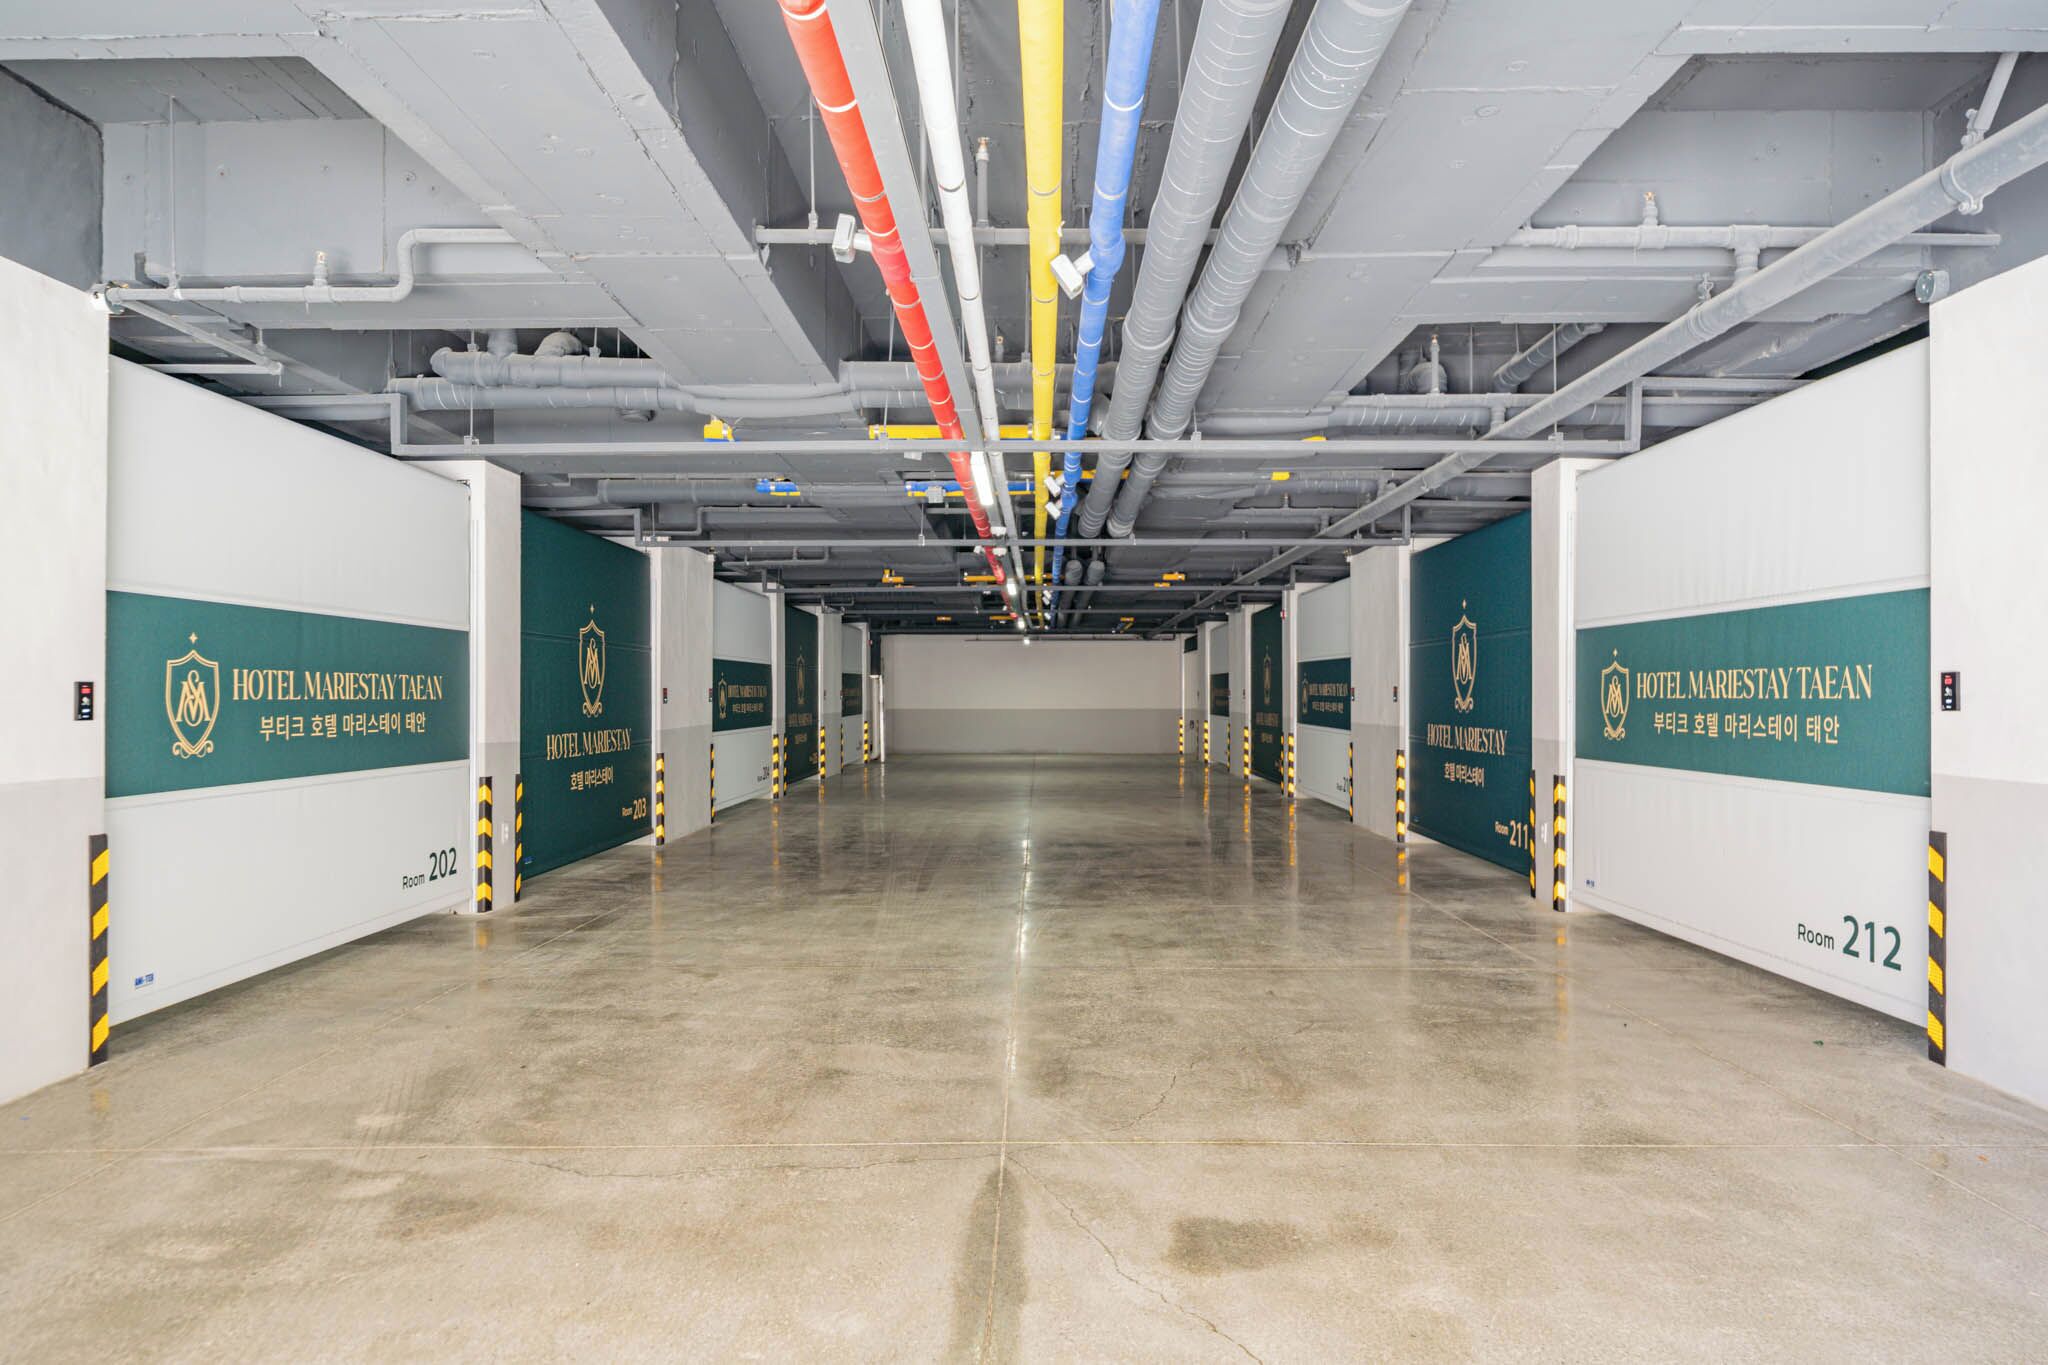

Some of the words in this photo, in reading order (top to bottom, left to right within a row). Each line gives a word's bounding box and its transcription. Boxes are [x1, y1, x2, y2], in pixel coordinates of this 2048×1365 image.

[233, 669, 301, 700] HOTEL
[304, 671, 398, 700] MARIESTAY
[399, 673, 443, 700] TAEAN
[1637, 671, 1686, 699] HOTEL
[1688, 667, 1793, 699] MARIESTAY
[1796, 664, 1872, 699] TAEAN
[260, 715, 304, 741] 부티크
[311, 714, 337, 738] 호텔
[343, 712, 400, 736] 마리스테이
[405, 712, 426, 733] 태안
[1427, 723, 1453, 749] HOTEL
[1654, 712, 1688, 735] 부티크
[1693, 712, 1718, 737] 호텔
[1725, 712, 1798, 742] 마리스테이
[1806, 714, 1840, 744] 태안
[546, 732, 581, 760] HOTEL
[582, 728, 631, 756] MARIESTAY
[633, 797, 647, 820] 203
[1510, 820, 1528, 850] 211
[402, 874, 425, 889] Room
[429, 847, 457, 881] 202
[1798, 922, 1835, 950] Room
[1842, 915, 1901, 971] 212
